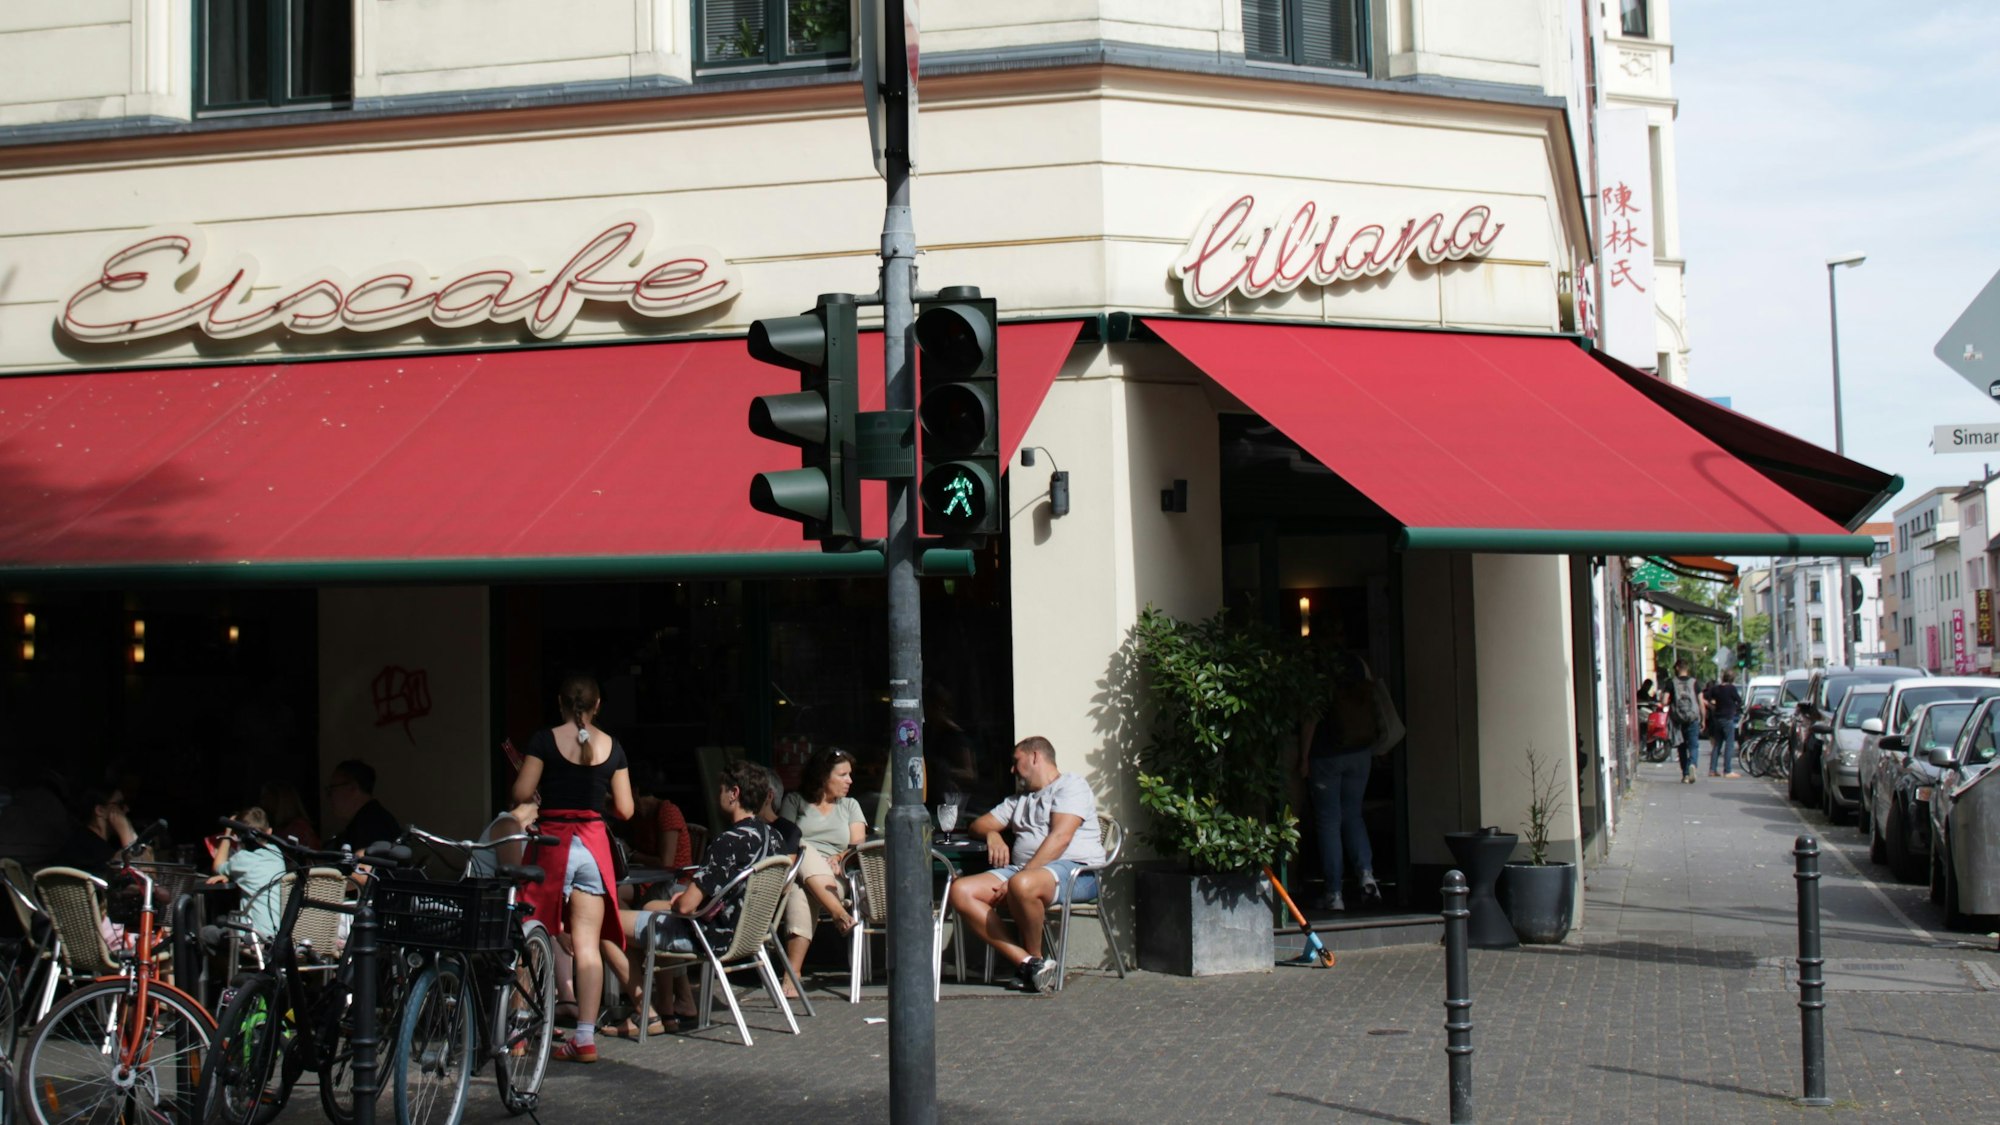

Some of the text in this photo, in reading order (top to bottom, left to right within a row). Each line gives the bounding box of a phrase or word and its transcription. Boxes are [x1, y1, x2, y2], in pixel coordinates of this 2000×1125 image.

[1602, 181, 1647, 293] 陳林氏
[1953, 611, 1964, 661] KIOSK
